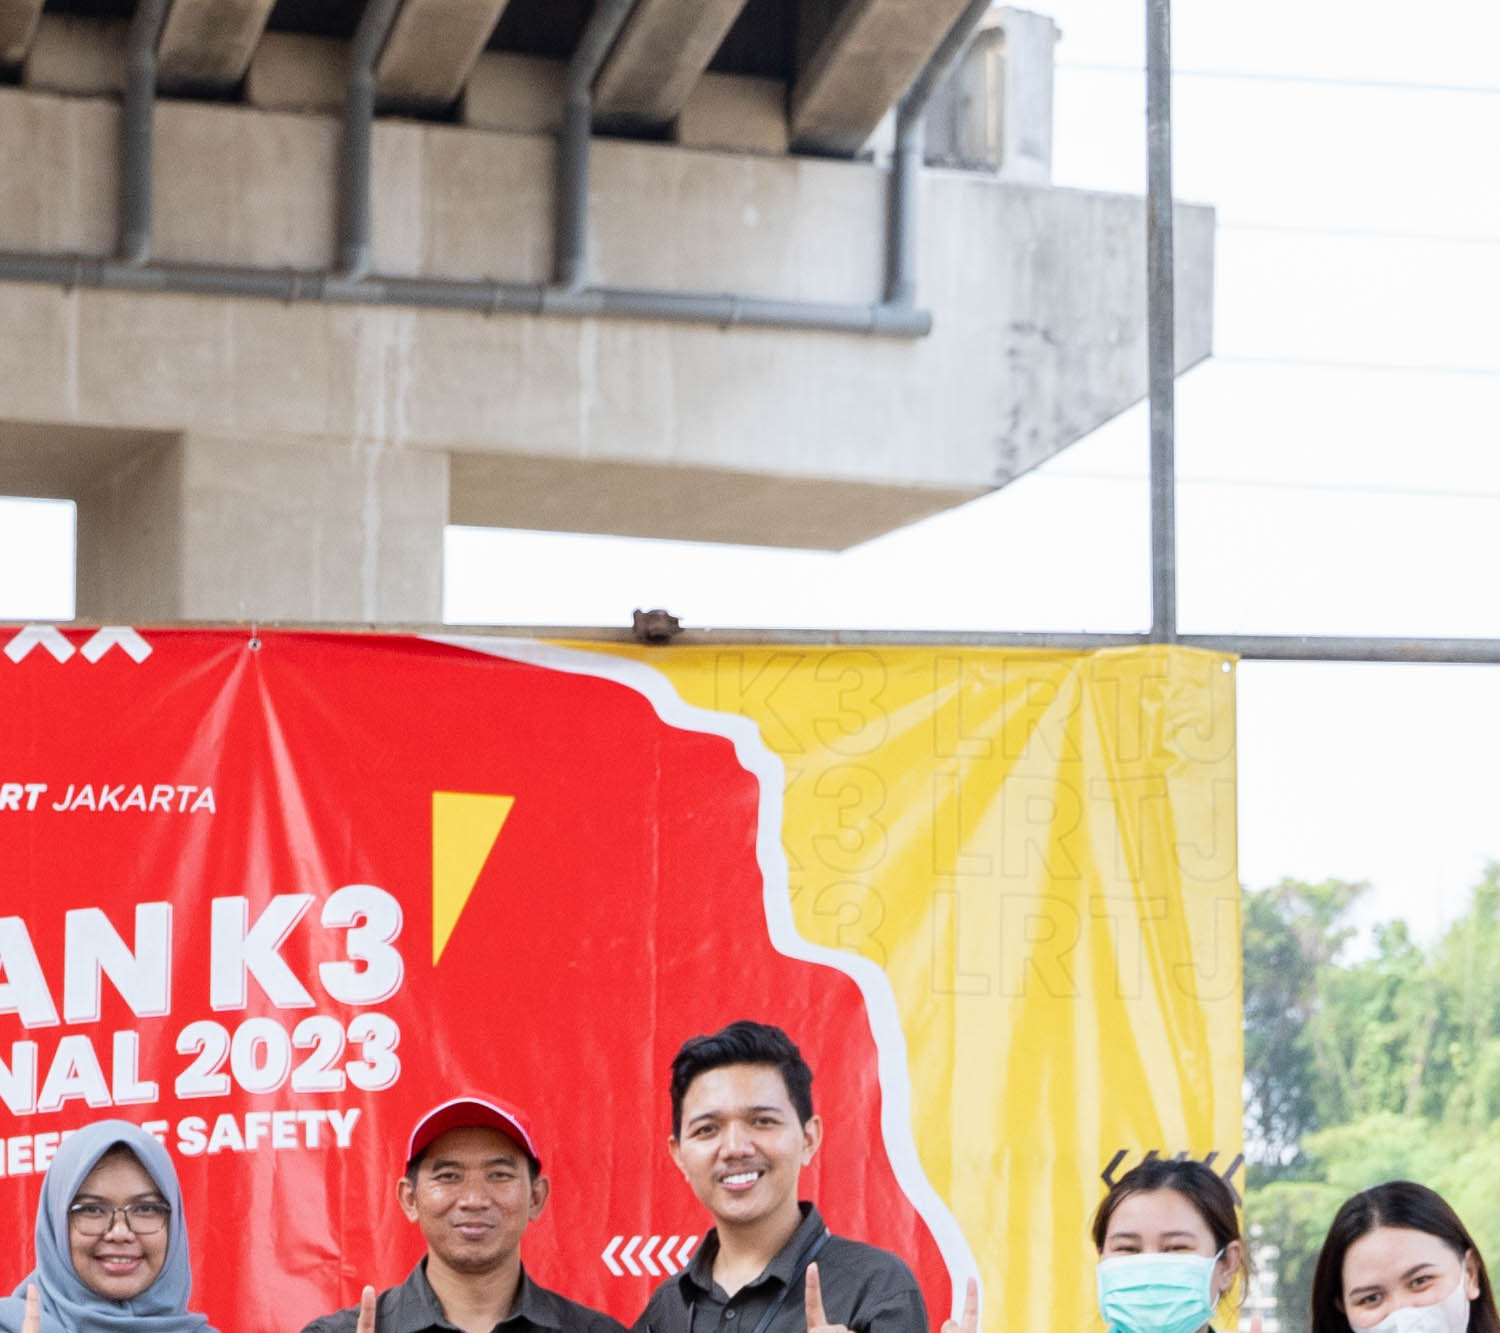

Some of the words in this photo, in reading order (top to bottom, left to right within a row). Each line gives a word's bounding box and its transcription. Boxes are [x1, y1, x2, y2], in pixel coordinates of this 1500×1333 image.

[52, 784, 217, 814] JAKARTA
[209, 884, 404, 1012] K3
[175, 1012, 401, 1099] 2023
[176, 1108, 361, 1156] SAFETY
